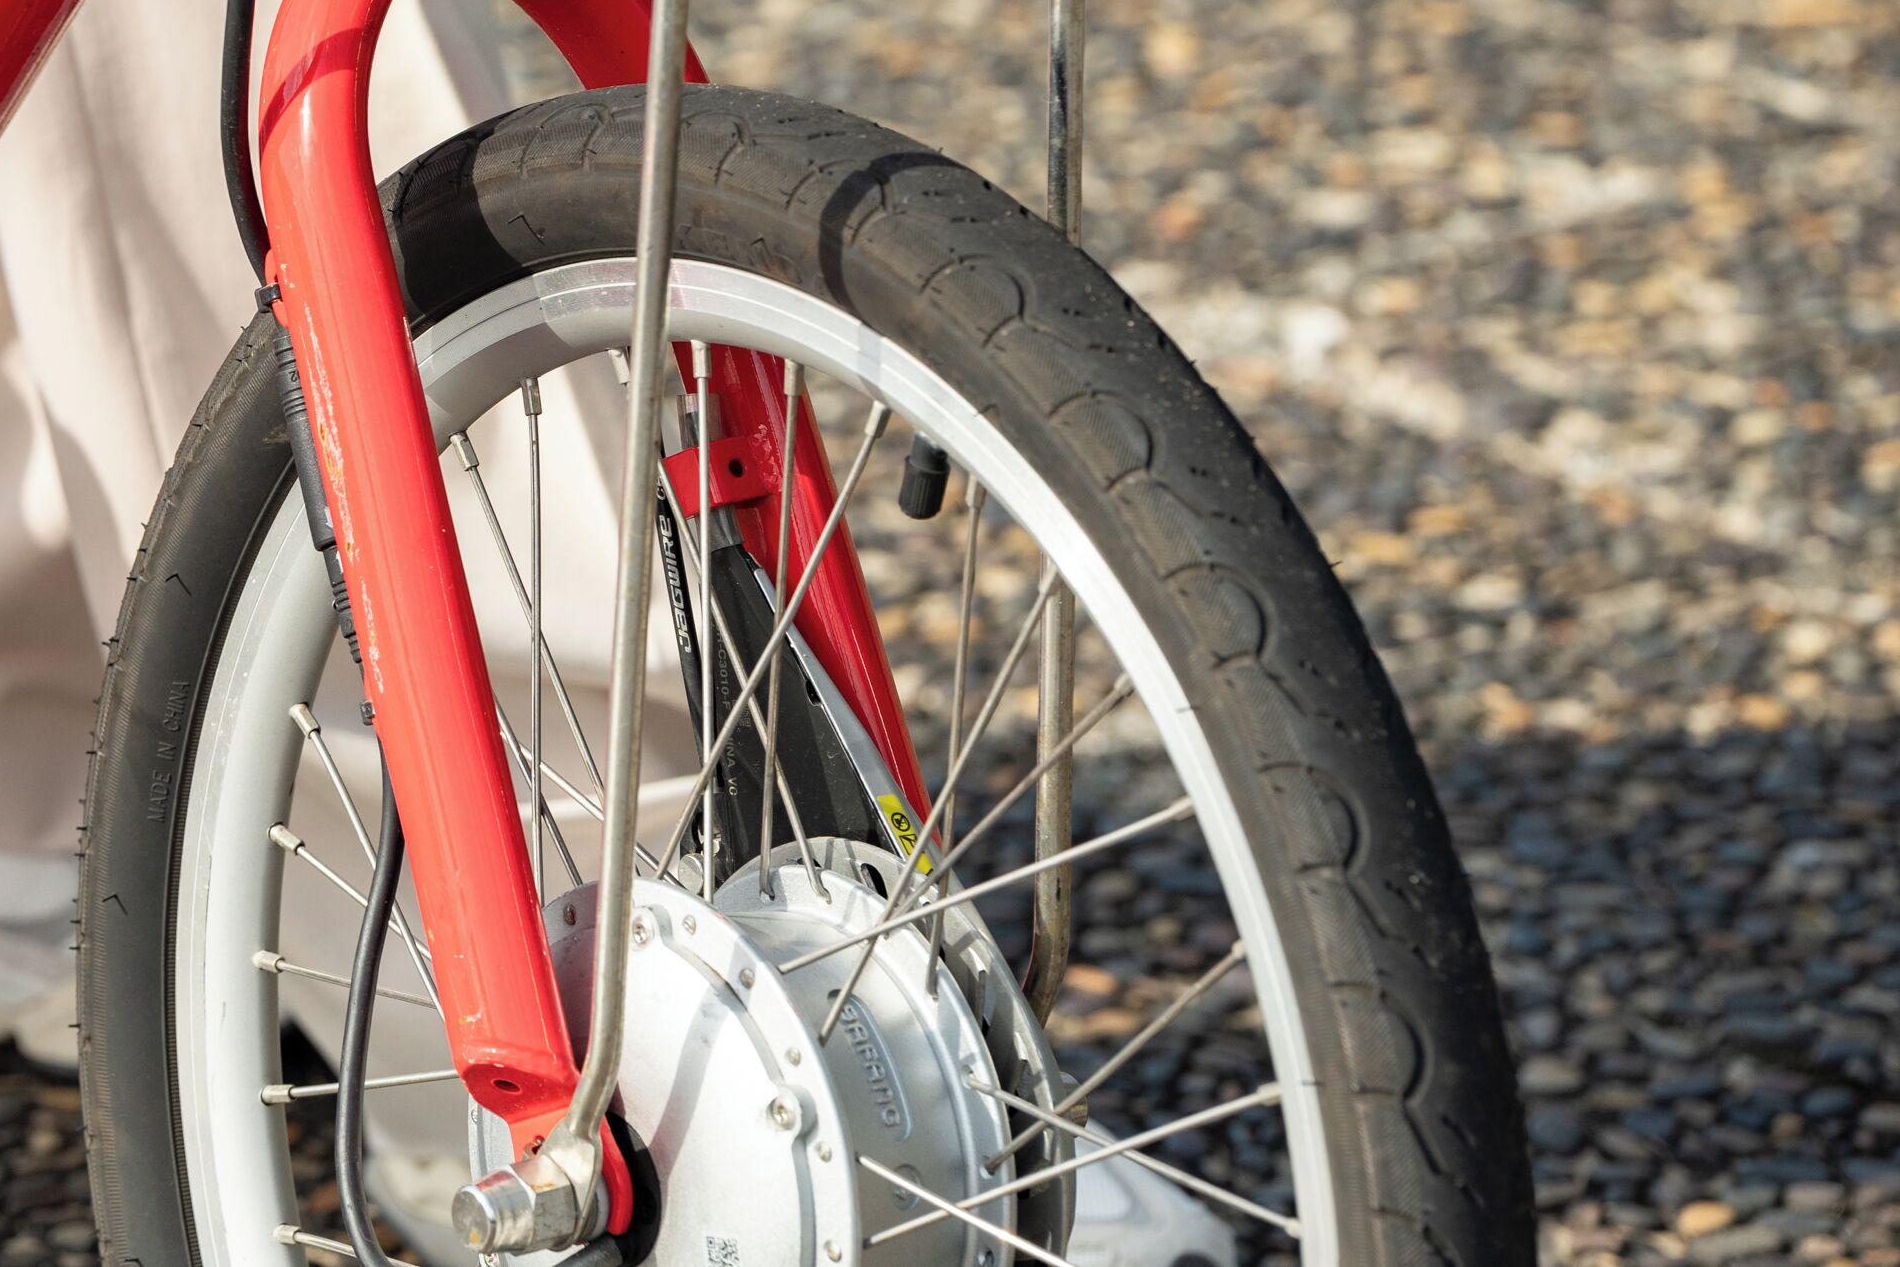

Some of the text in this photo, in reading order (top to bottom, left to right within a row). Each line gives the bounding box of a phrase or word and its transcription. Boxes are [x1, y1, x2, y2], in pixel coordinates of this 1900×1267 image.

[147, 680, 190, 824] MADE IN CHINA
